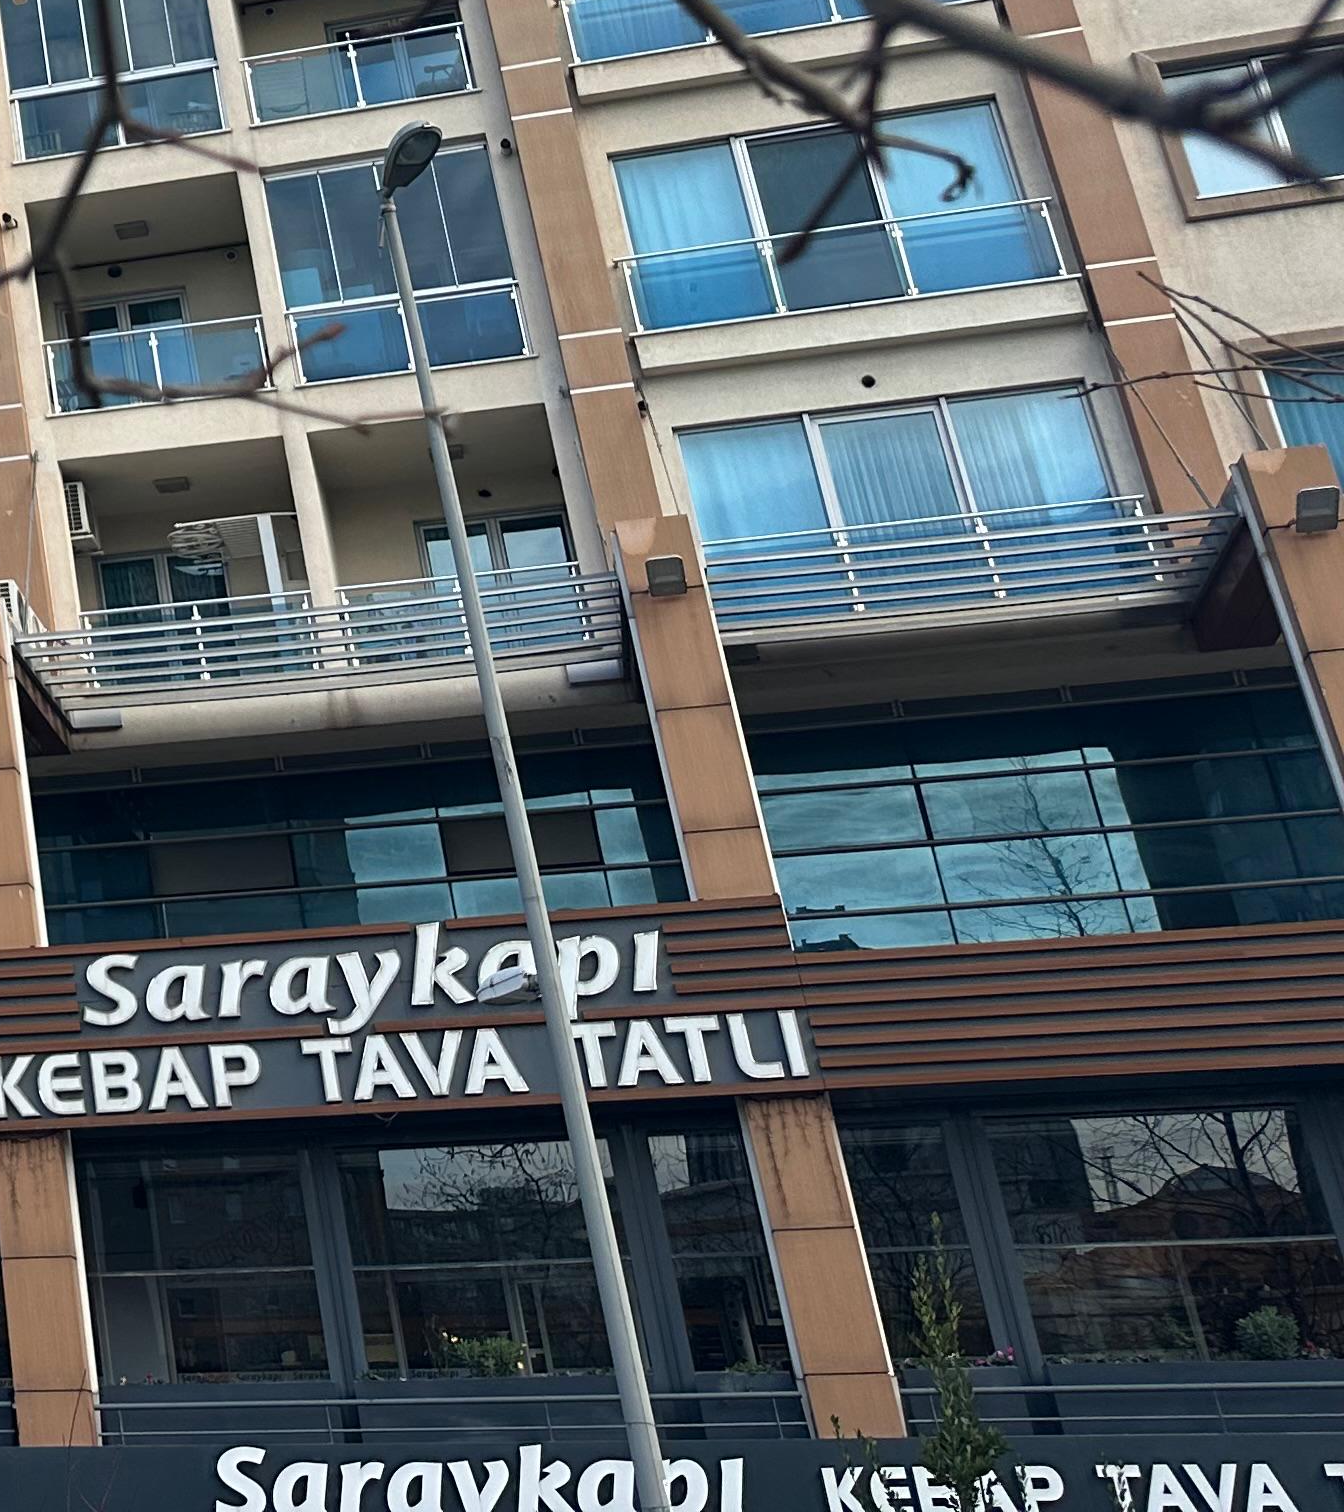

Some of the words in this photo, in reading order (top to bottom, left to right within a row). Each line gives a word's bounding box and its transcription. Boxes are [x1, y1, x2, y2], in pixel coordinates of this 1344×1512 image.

[300, 1028, 530, 1103] TAVA
[571, 1009, 810, 1088] TATLI
[1095, 1463, 1307, 1512] TAVA
